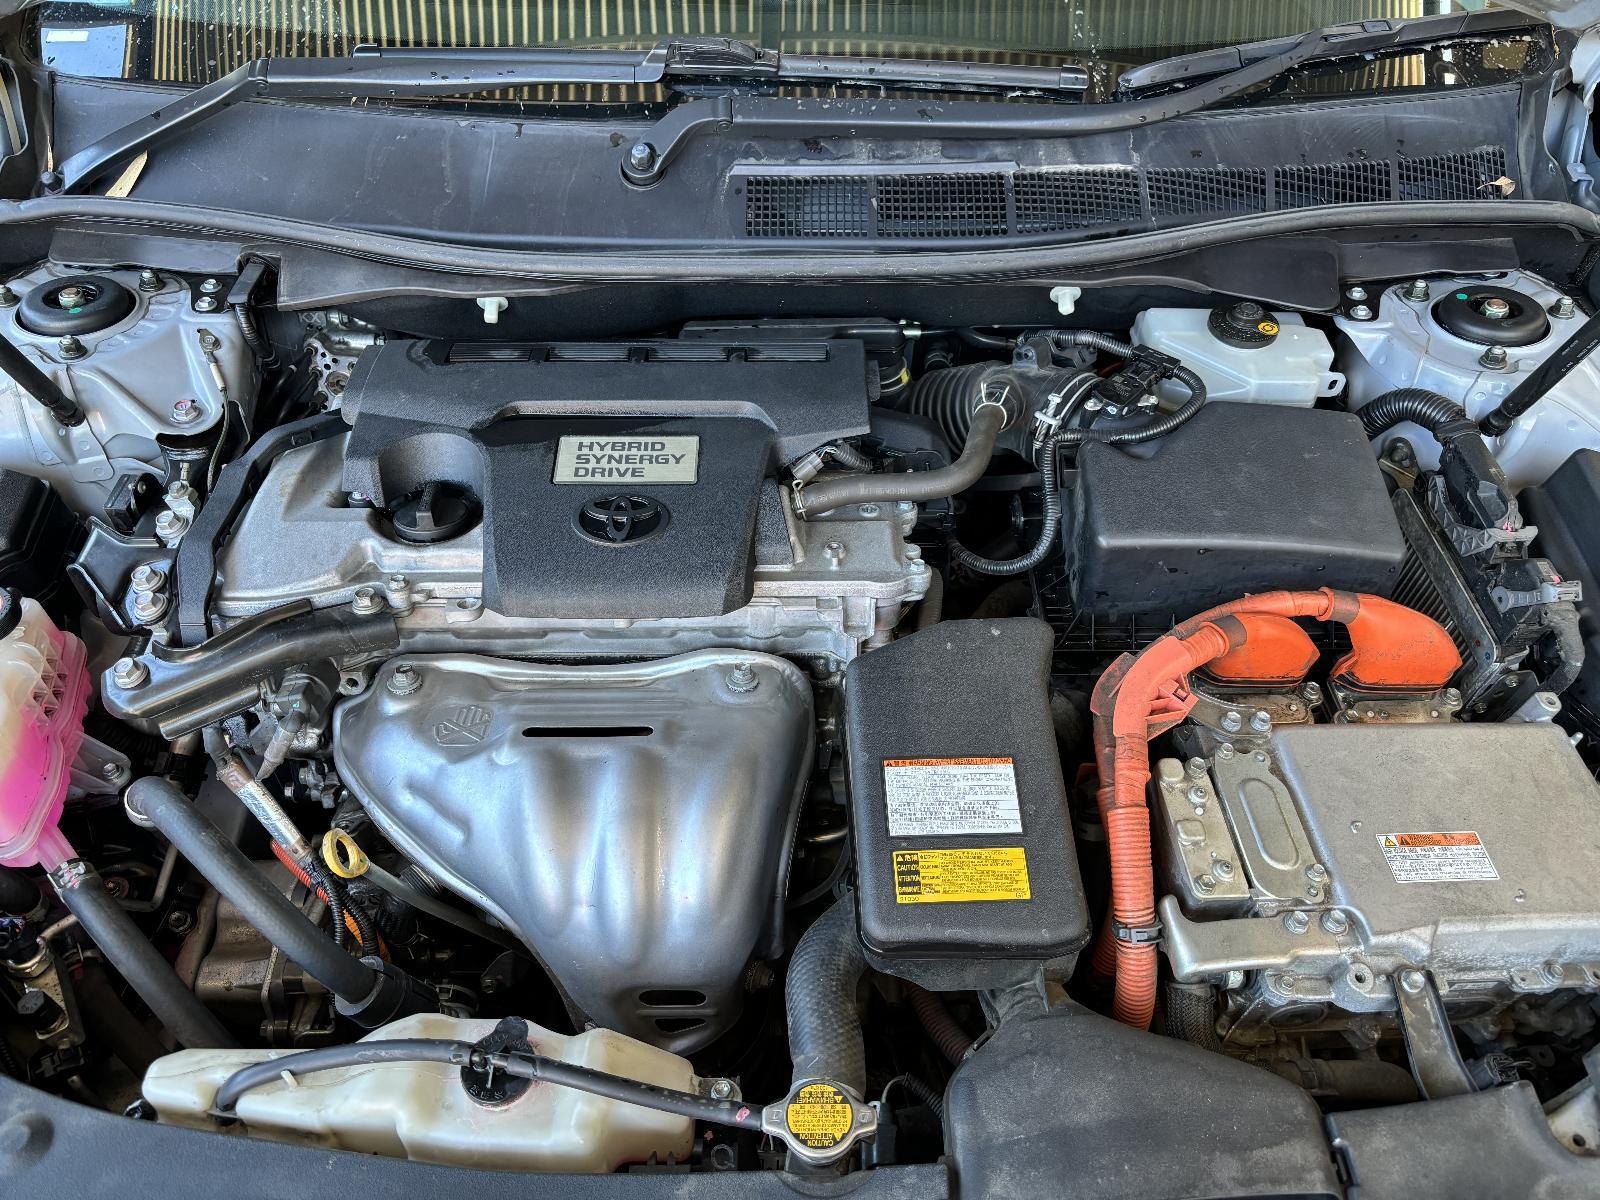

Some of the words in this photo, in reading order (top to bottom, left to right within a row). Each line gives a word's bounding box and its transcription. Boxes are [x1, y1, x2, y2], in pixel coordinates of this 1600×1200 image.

[577, 441, 666, 452] HYBRID
[575, 453, 687, 465] SYNERGY
[573, 467, 646, 478] DRIVE
[807, 1139, 834, 1147] CAUTION
